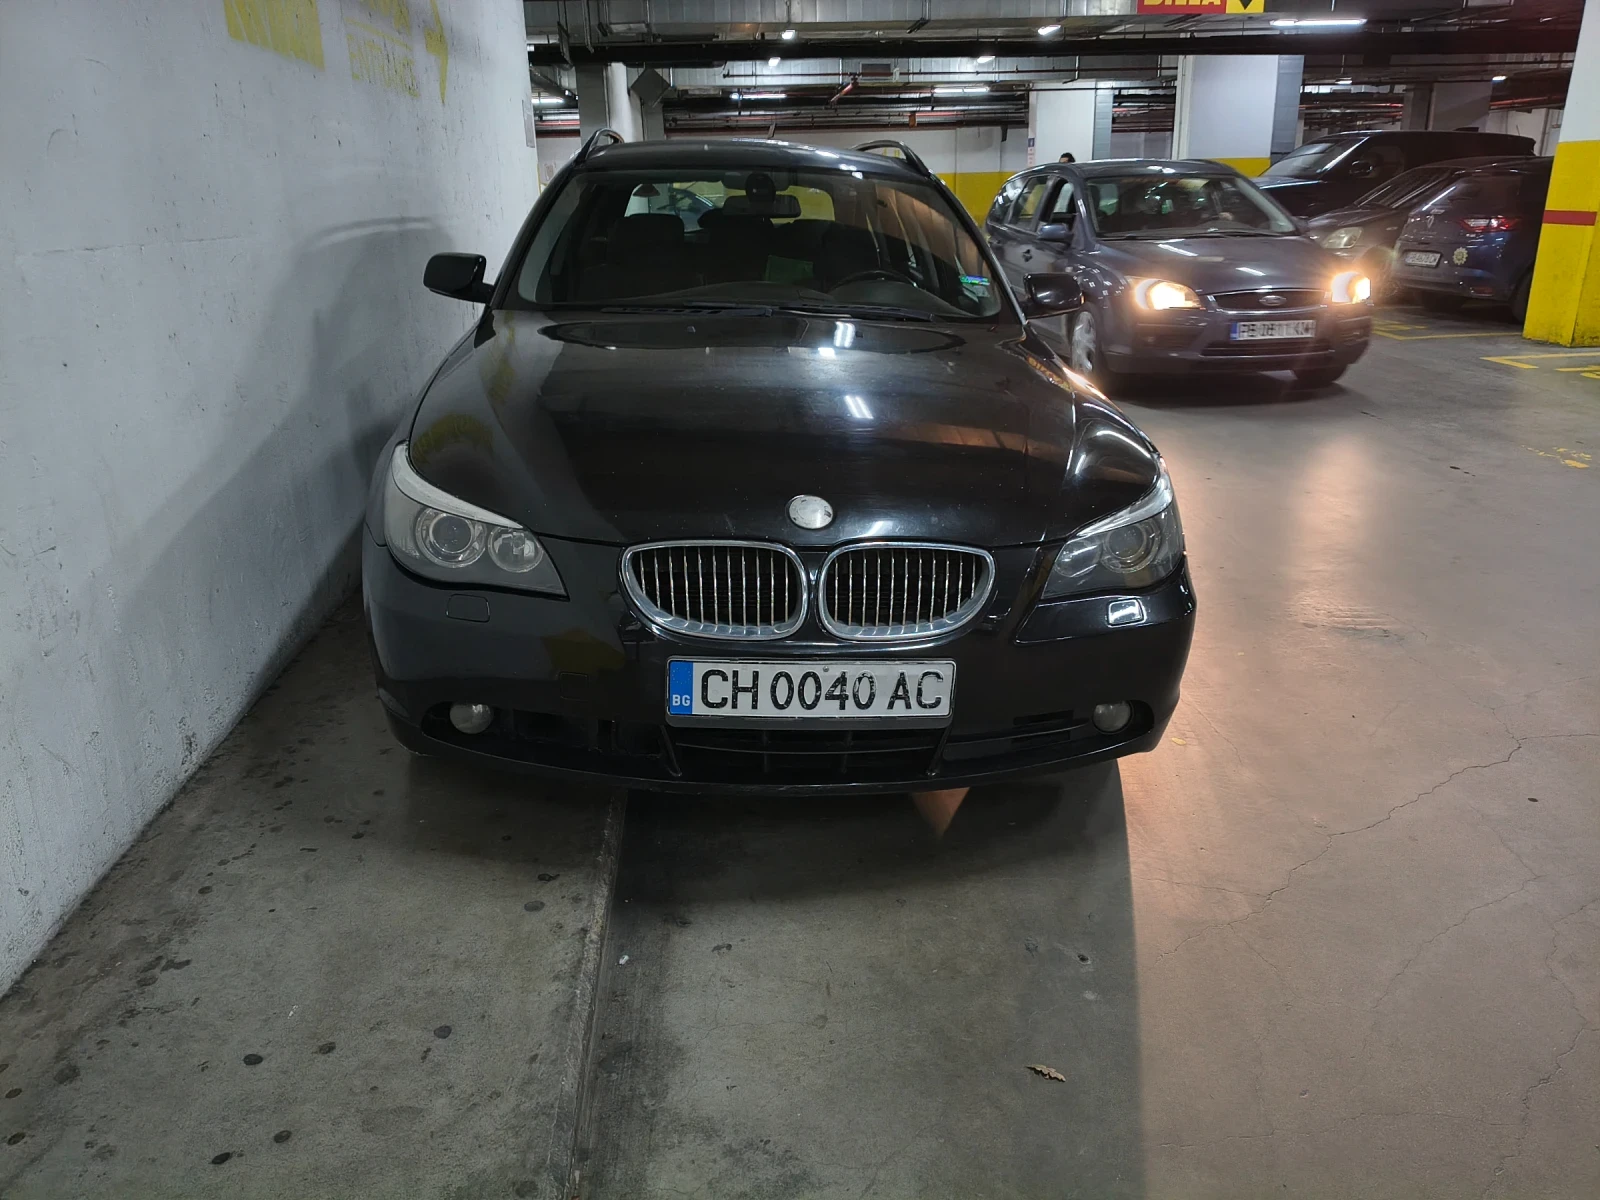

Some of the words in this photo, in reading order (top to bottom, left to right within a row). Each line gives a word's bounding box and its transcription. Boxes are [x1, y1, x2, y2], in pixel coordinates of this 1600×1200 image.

[672, 694, 691, 706] BG
[701, 669, 759, 709] CH
[770, 670, 877, 710] 0040
[886, 669, 944, 709] AC
